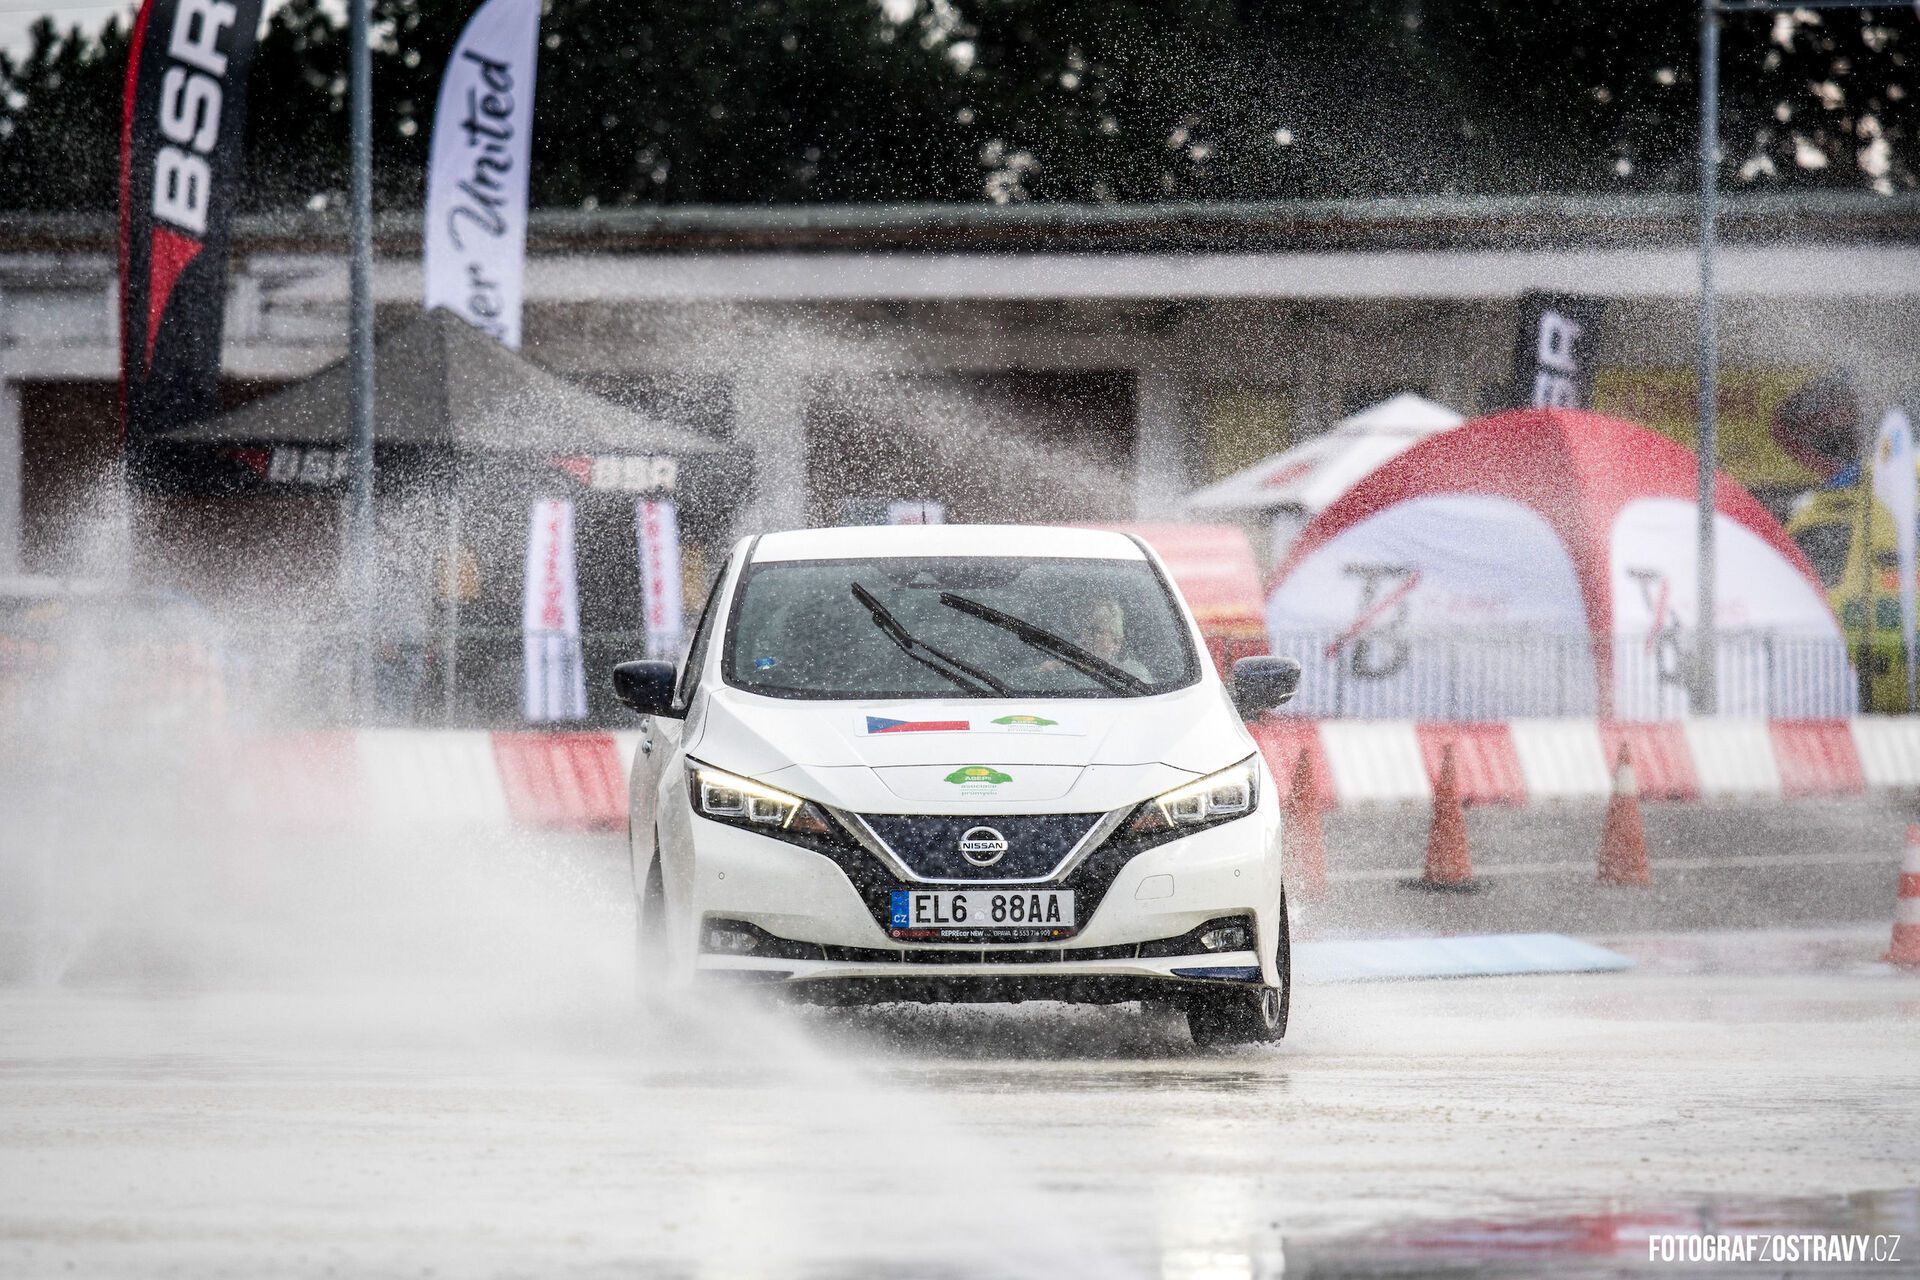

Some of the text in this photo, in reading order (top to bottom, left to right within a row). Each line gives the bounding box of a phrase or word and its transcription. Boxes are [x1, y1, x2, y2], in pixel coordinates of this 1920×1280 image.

[152, 0, 237, 236] BSR
[448, 48, 515, 250] United
[893, 915, 907, 923] CZ
[915, 894, 1061, 923] EL6 88AA
